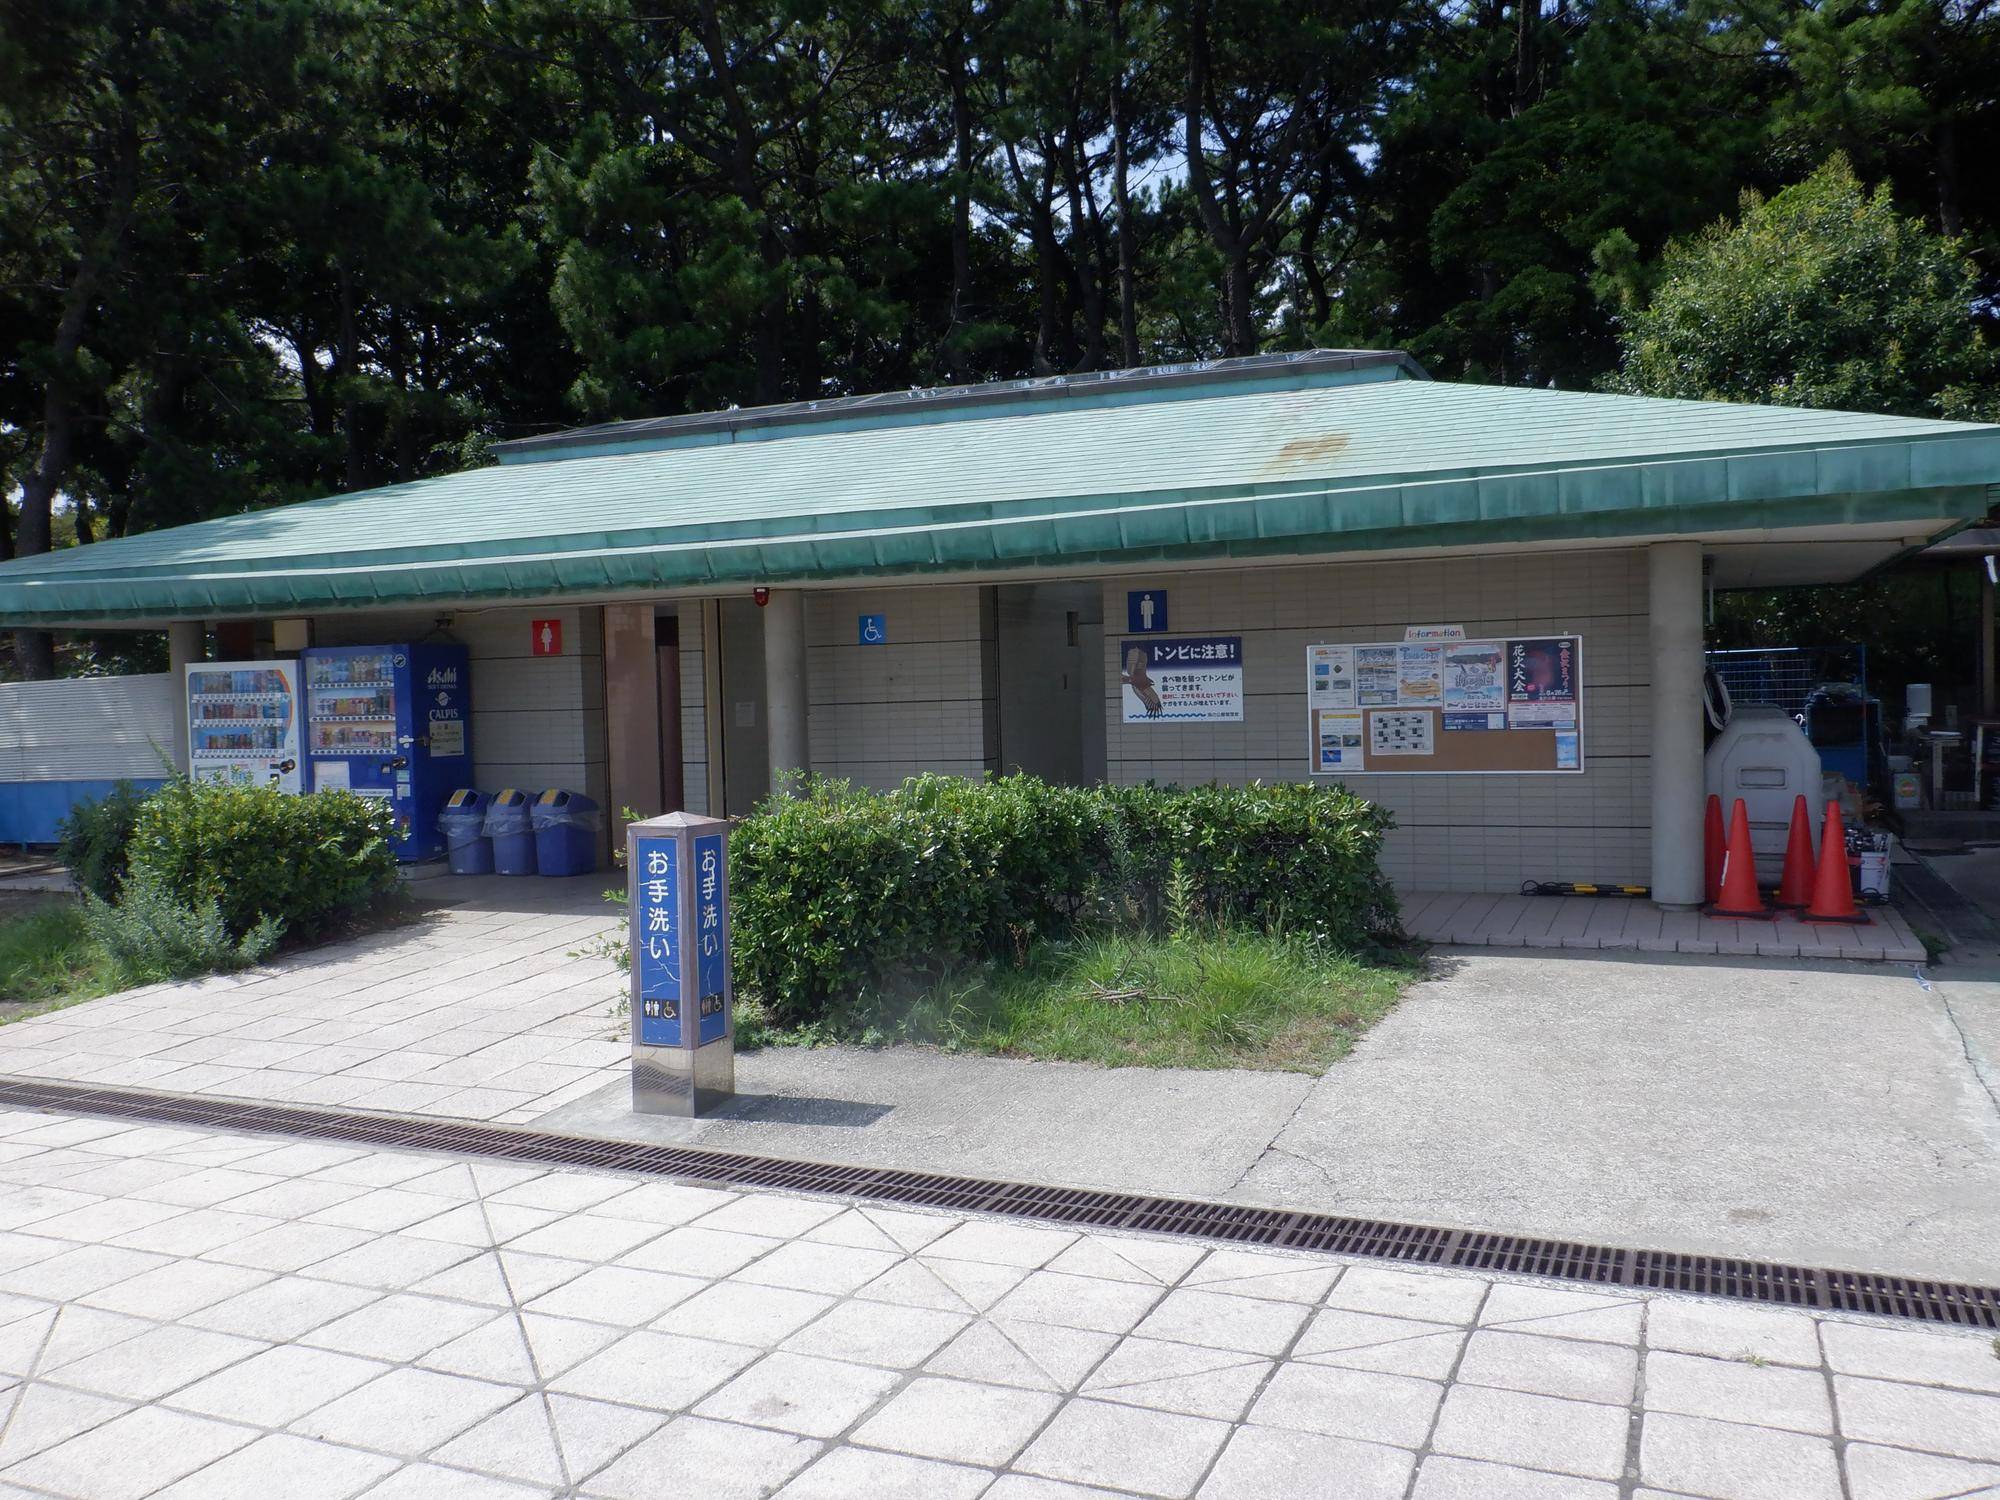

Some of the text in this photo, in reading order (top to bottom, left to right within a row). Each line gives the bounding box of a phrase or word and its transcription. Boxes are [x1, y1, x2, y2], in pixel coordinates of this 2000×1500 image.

[1408, 628, 1461, 640] Information
[1154, 644, 1234, 661] トンビに注意！
[427, 666, 457, 684] Asahi
[1512, 644, 1526, 692] 花火大会
[429, 709, 458, 722] CALPIS
[648, 850, 670, 959] お手洗い
[702, 849, 718, 956] お手洗い
